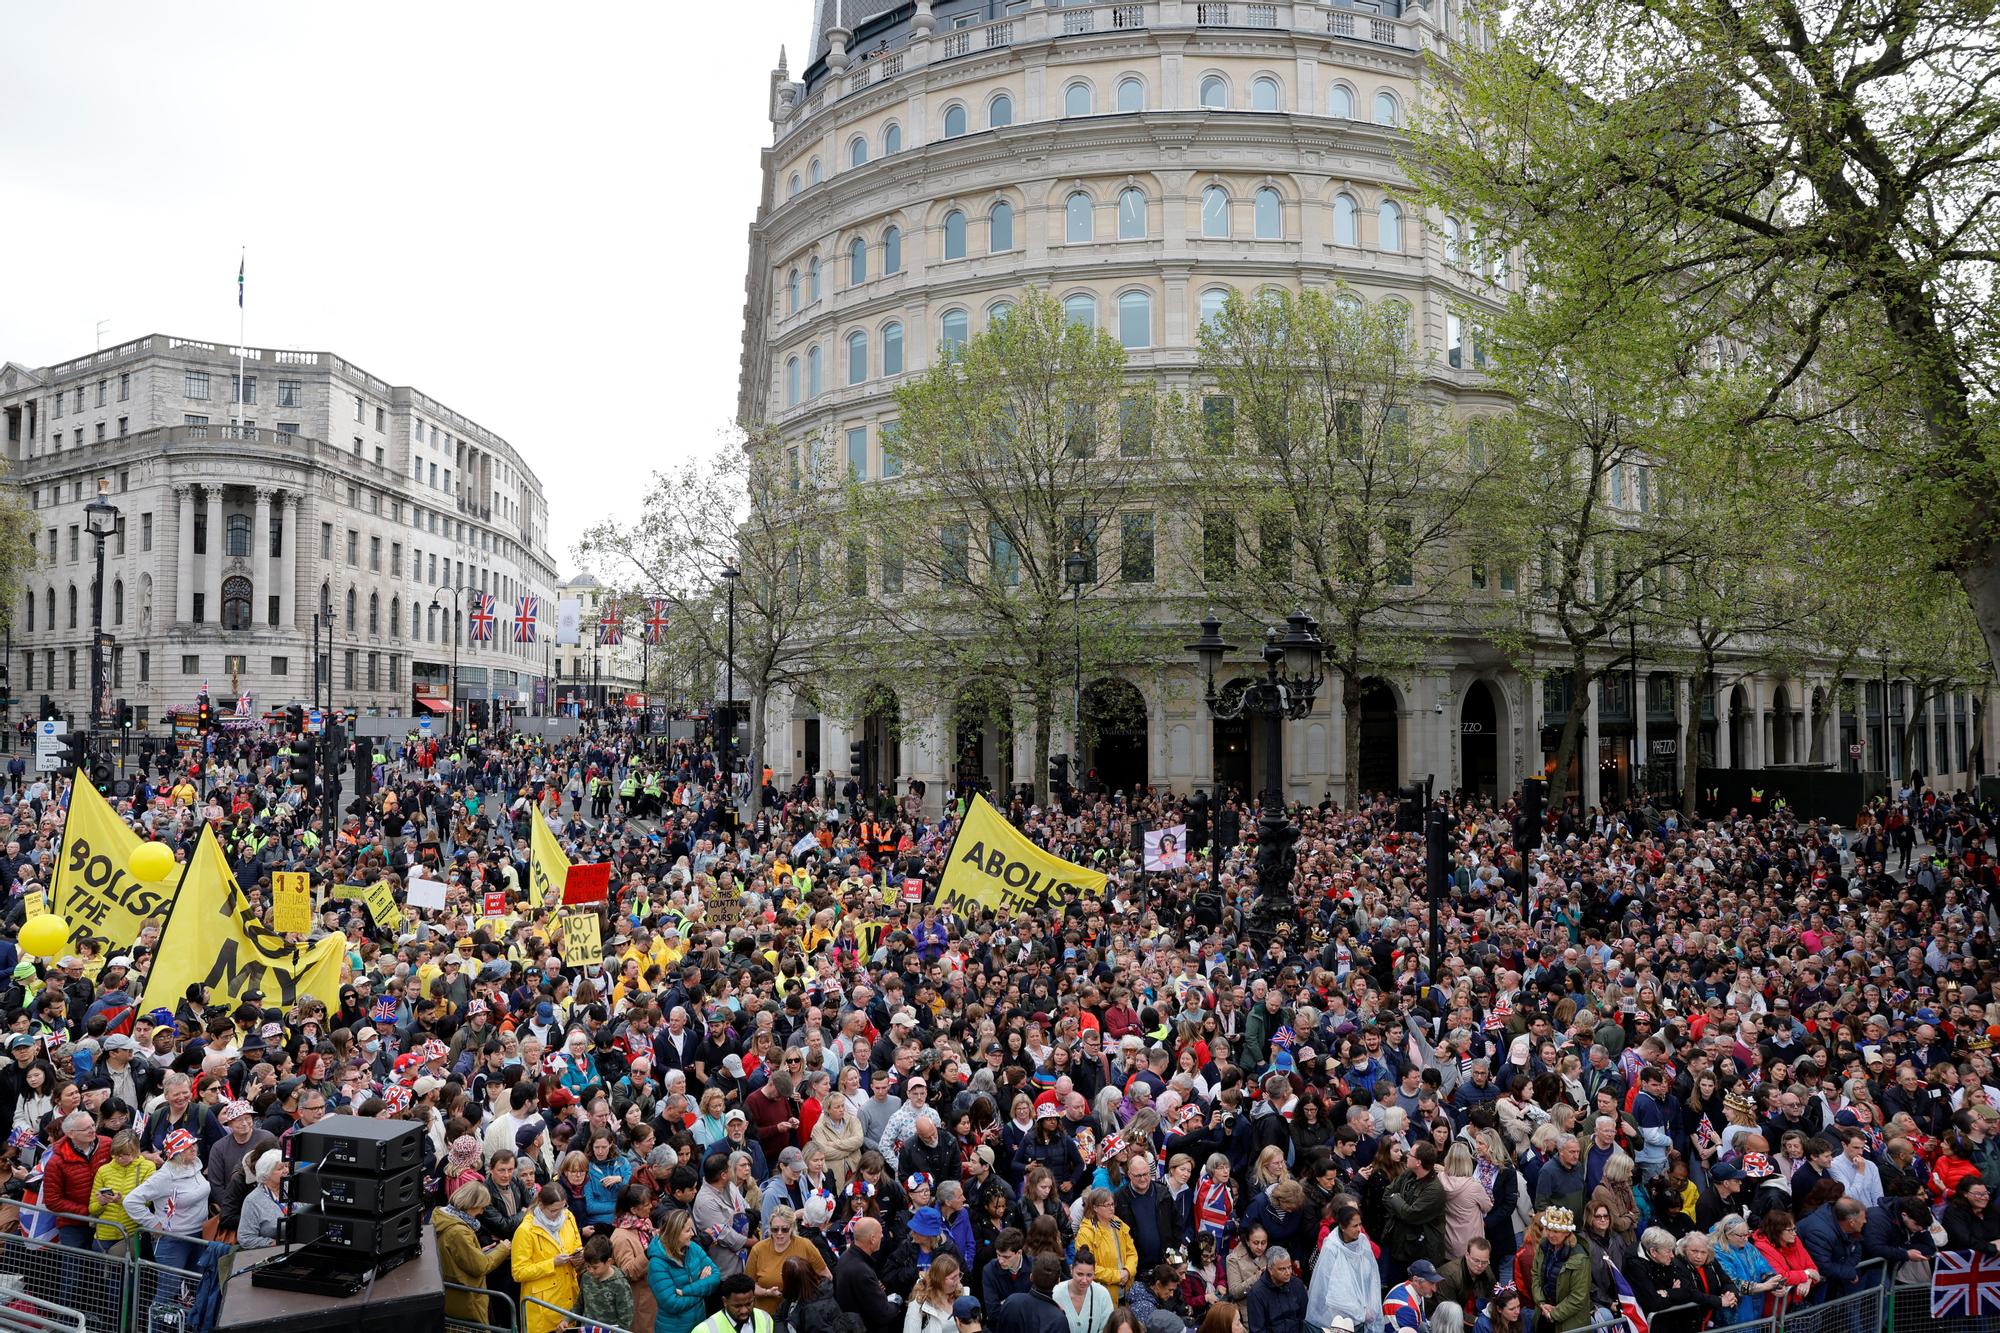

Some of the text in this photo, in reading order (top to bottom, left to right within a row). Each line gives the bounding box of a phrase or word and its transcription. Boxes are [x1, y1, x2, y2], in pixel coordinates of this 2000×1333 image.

[183, 463, 296, 480] SUID-AFRIKA
[1652, 739, 1677, 755] PREZZO
[718, 891, 732, 899] THIS
[66, 885, 111, 926] THE
[710, 899, 739, 909] COUNTRY
[721, 906, 727, 914] IS
[564, 914, 596, 935] NOT
[570, 932, 591, 945] MY
[205, 938, 319, 1006] MY
